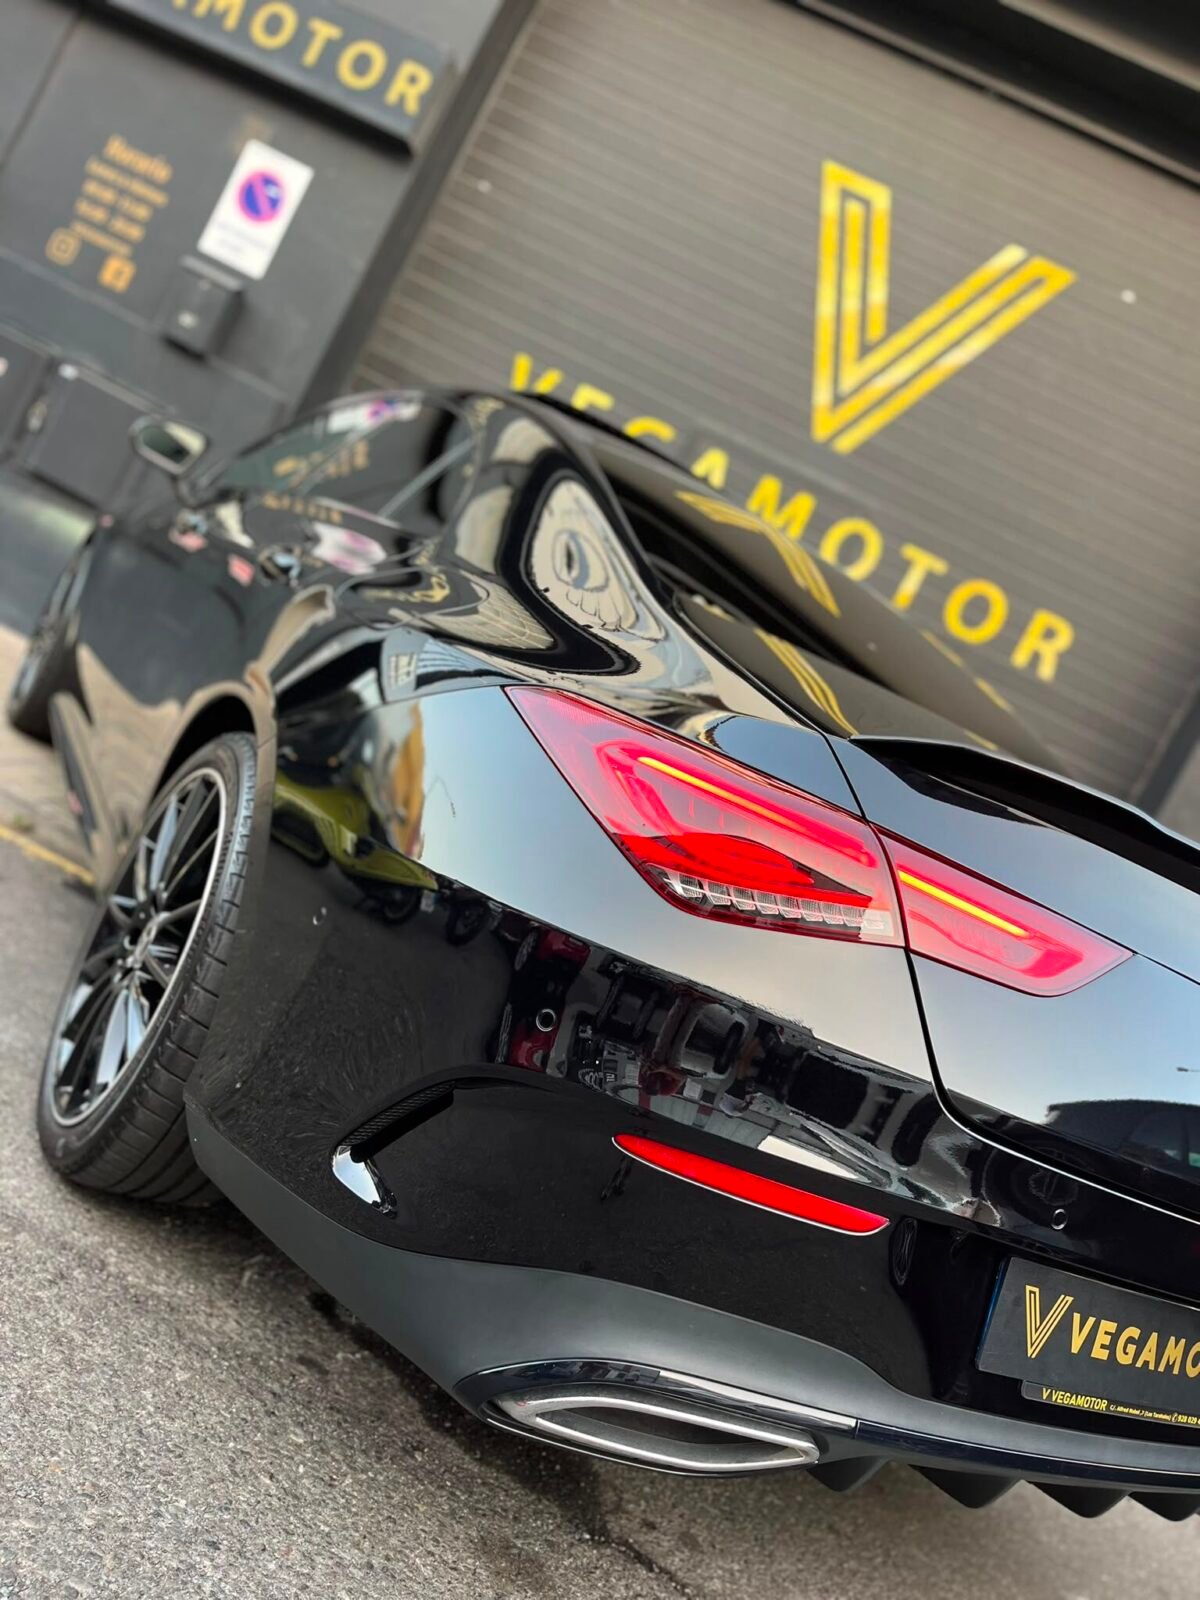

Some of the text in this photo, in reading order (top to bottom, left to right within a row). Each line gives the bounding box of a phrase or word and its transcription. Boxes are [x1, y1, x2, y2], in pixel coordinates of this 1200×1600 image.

[172, 0, 433, 114] MOTOR
[812, 161, 1076, 453] V
[1025, 1284, 1074, 1359] V
[1042, 1387, 1051, 1400] V
[1052, 1390, 1108, 1411] VEGAMOTOR
